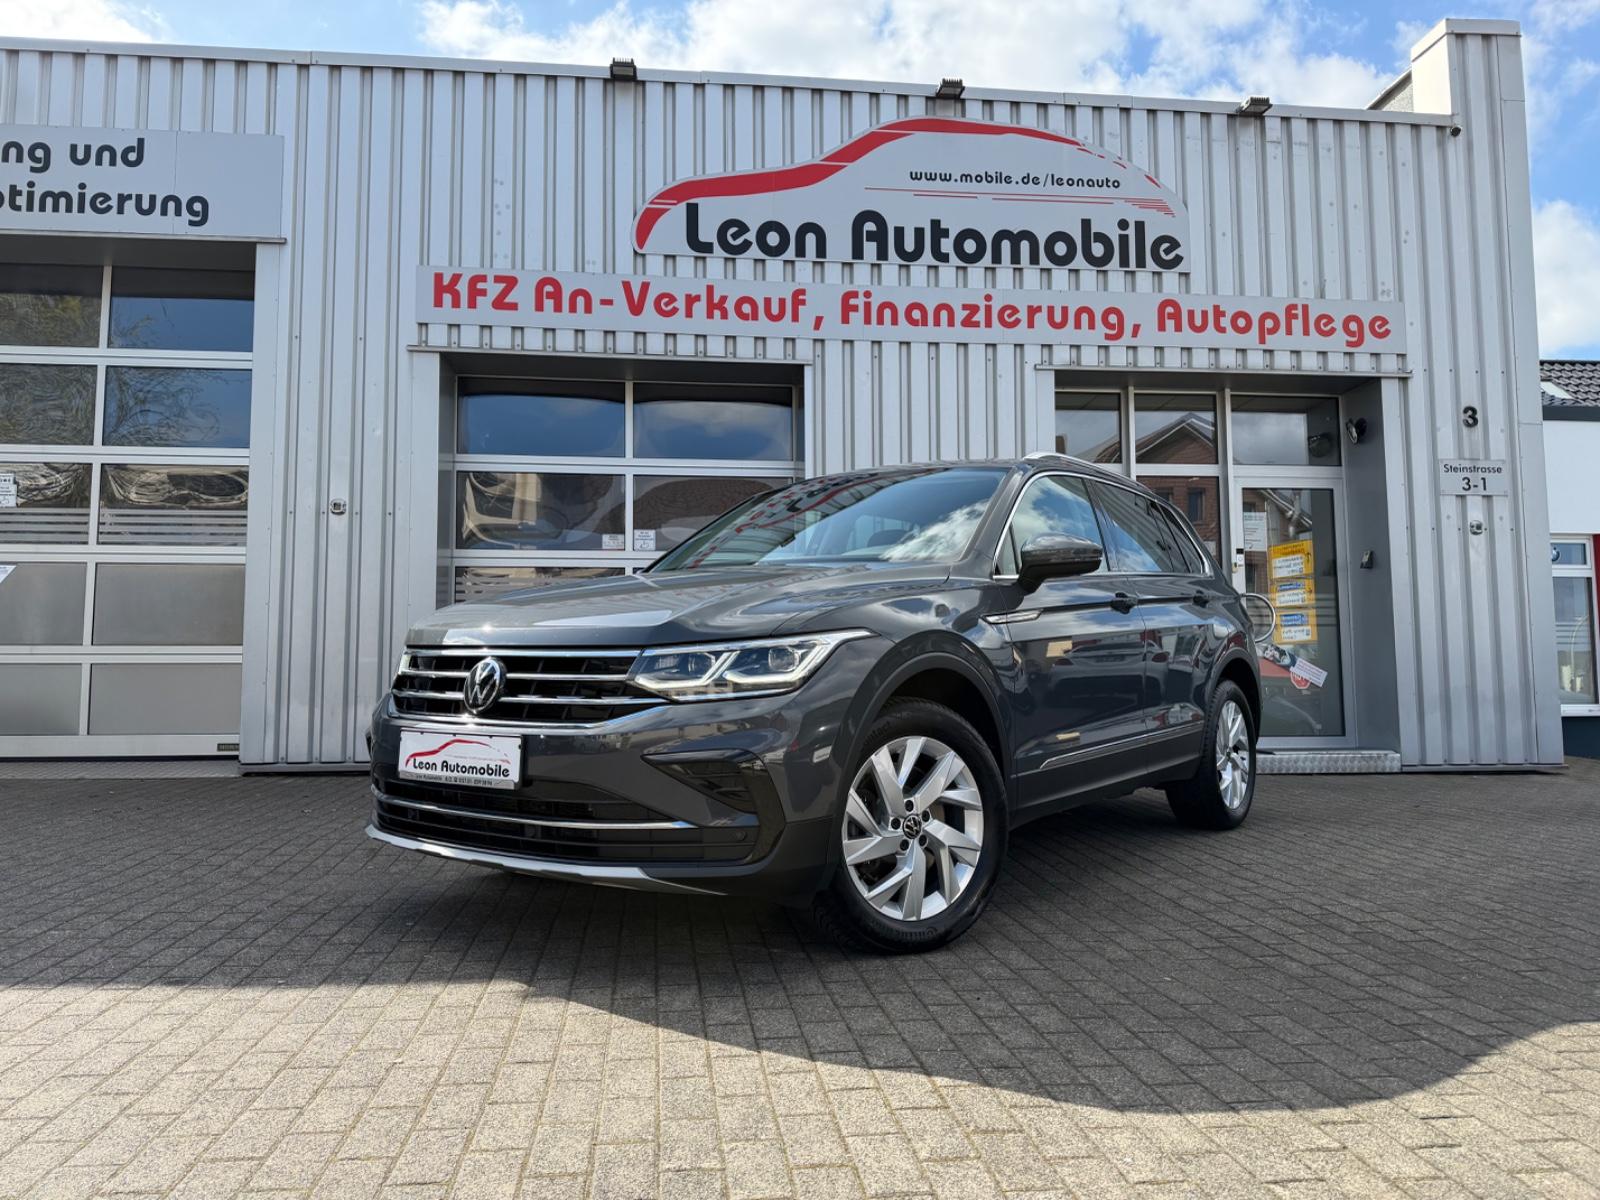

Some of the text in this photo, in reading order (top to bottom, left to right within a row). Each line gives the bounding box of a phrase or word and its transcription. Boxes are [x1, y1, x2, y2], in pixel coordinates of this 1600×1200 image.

[69, 137, 145, 168] und
[909, 170, 1121, 189] www.mobile.de/leonauto
[0, 180, 210, 228] timierung
[686, 202, 1184, 271] Leon Automobile
[840, 289, 1141, 342] Finanzierung,
[1156, 298, 1391, 349] Autopflege
[1462, 405, 1479, 429] 3
[1443, 463, 1503, 474] Steinstrasse
[1461, 476, 1487, 492] 3-1
[413, 758, 510, 778] Leon Automobile
